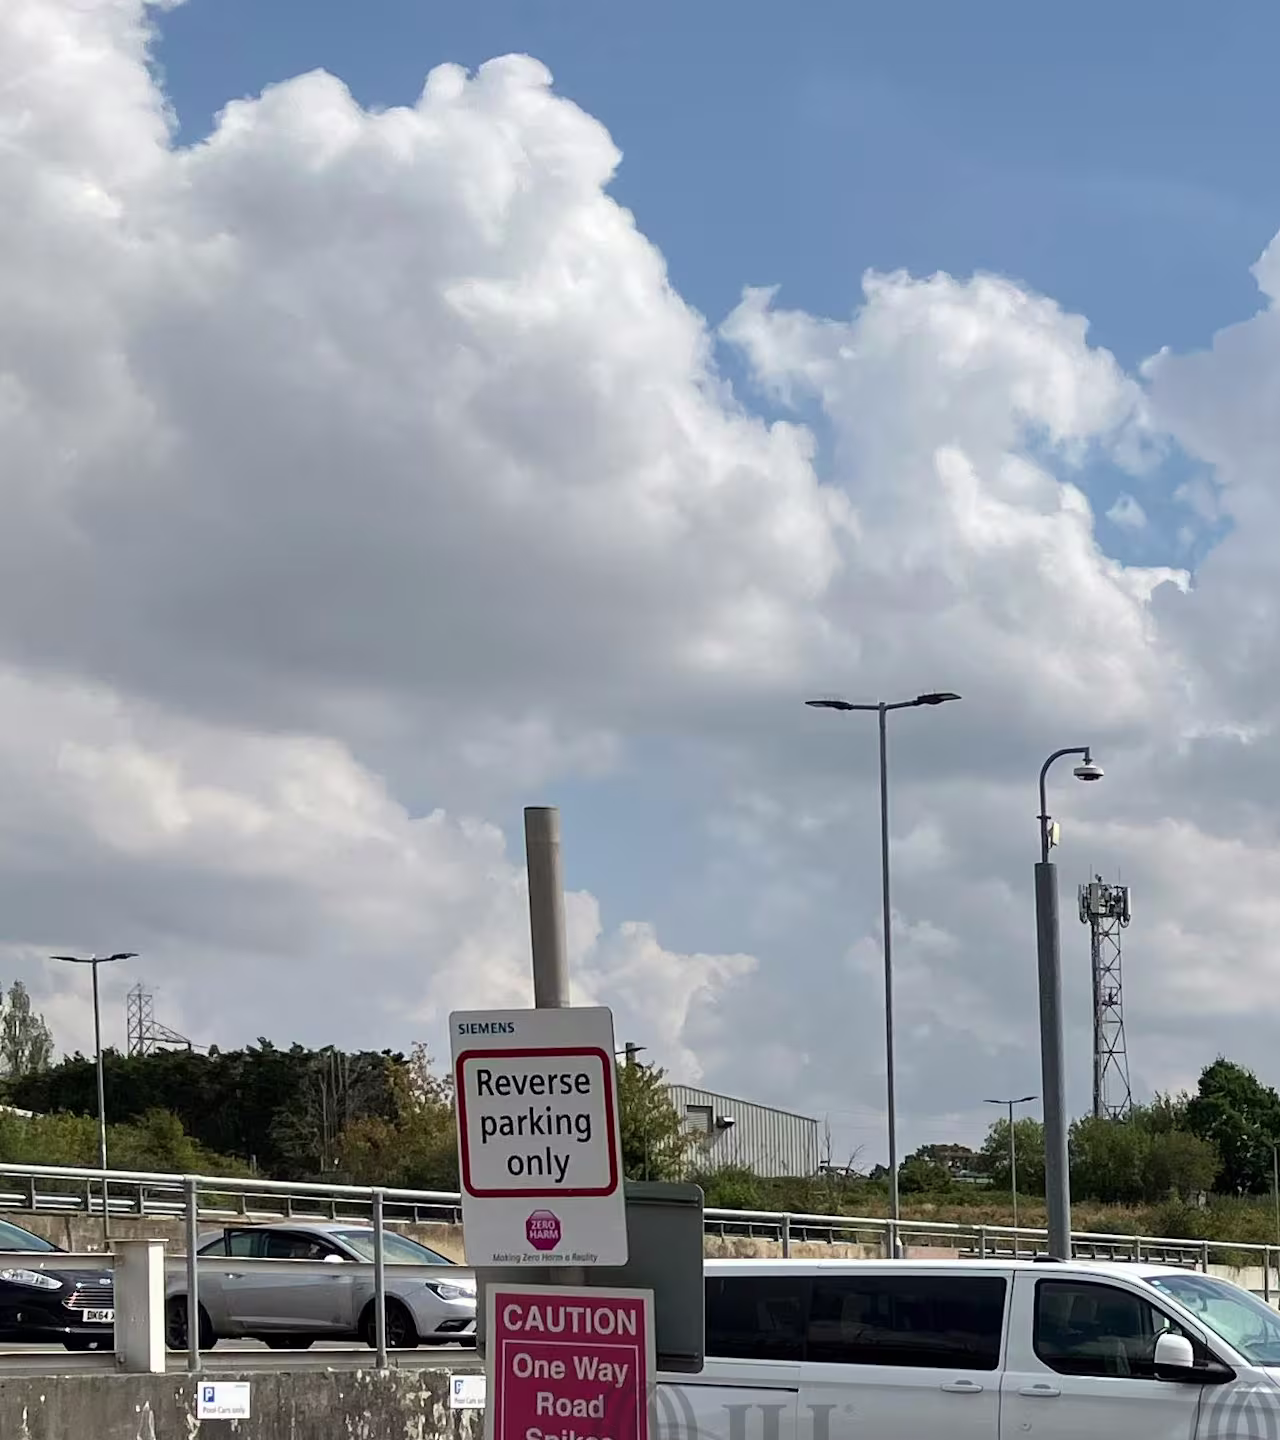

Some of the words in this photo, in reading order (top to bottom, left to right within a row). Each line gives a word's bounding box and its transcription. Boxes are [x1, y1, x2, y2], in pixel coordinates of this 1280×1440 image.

[458, 1022, 515, 1034] SIEMENS
[476, 1069, 591, 1096] Reverse
[480, 1106, 592, 1144] parking
[507, 1146, 570, 1183] only
[530, 1230, 559, 1239] HARM
[531, 1220, 556, 1230] ZERO
[493, 1253, 520, 1264] Making
[521, 1253, 540, 1262] Zero
[542, 1253, 563, 1262] Harm
[572, 1253, 598, 1263] Reality
[503, 1304, 637, 1336] CAUTION
[513, 1353, 566, 1380] One
[573, 1356, 629, 1388] Way
[232, 1405, 245, 1415] only
[536, 1391, 604, 1418] Road
